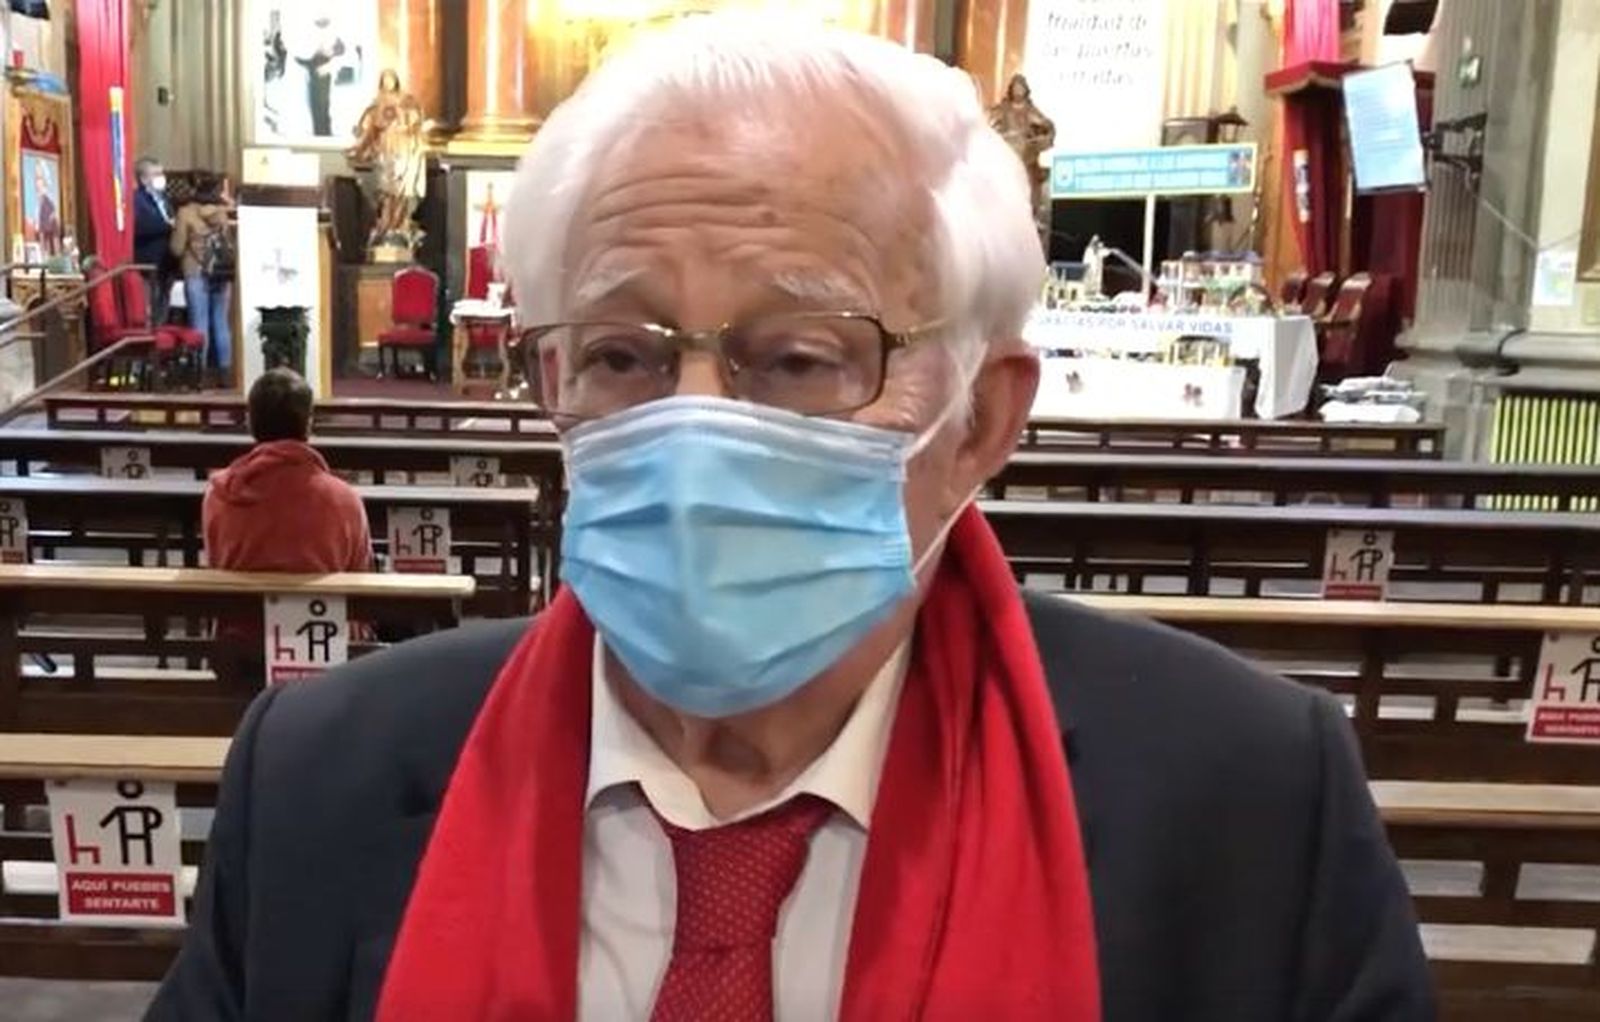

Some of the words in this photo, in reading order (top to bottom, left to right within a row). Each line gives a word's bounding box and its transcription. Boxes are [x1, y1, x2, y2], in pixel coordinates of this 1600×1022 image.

[1131, 320, 1186, 332] SALVAR
[1189, 321, 1234, 334] VIDAS
[111, 881, 171, 893] PUEDES
[84, 897, 160, 909] SENTARTE
